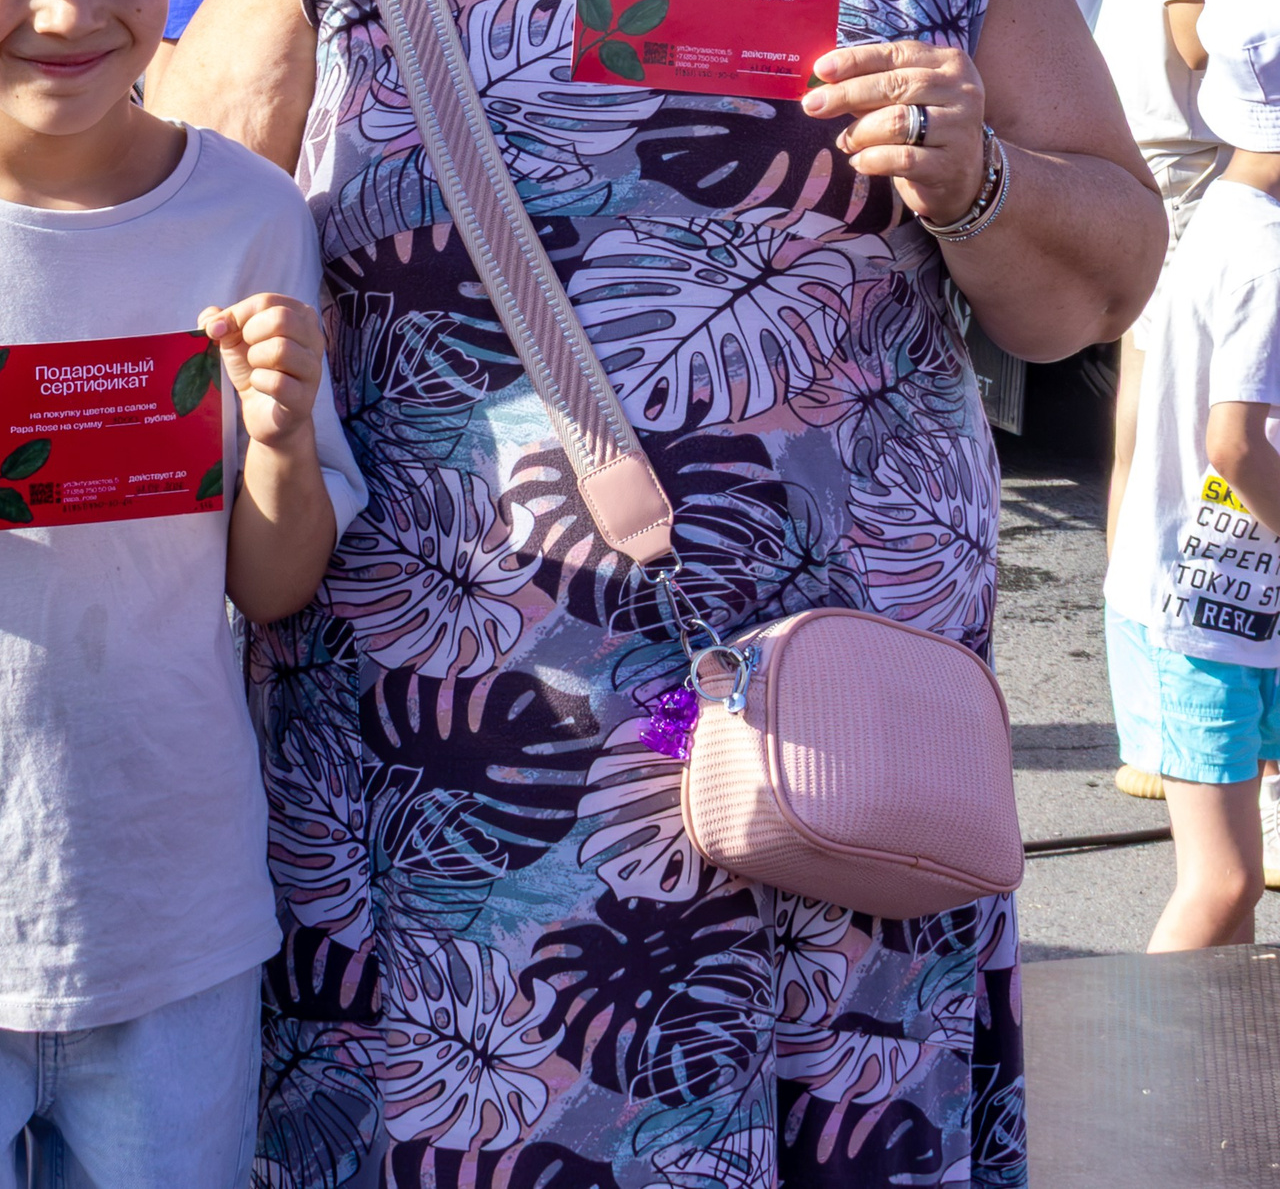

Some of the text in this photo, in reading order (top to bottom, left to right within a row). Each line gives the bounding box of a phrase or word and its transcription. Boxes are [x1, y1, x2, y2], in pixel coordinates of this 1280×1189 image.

[741, 49, 800, 62] действует до
[35, 357, 154, 380] Подарочный
[40, 374, 149, 396] сертификат
[43, 409, 81, 420] покупку
[83, 407, 115, 417] цветов
[125, 402, 157, 413] салоне
[10, 426, 33, 435] Papa
[35, 424, 58, 433] Rose
[60, 423, 71, 431] на
[73, 421, 102, 432] сумму
[144, 413, 176, 424] рублей
[128, 469, 187, 483] действует до
[1205, 480, 1245, 509] SK
[1197, 506, 1261, 541] COOL
[1177, 564, 1250, 601] TOKYO
[1162, 594, 1257, 637] IT REAL
